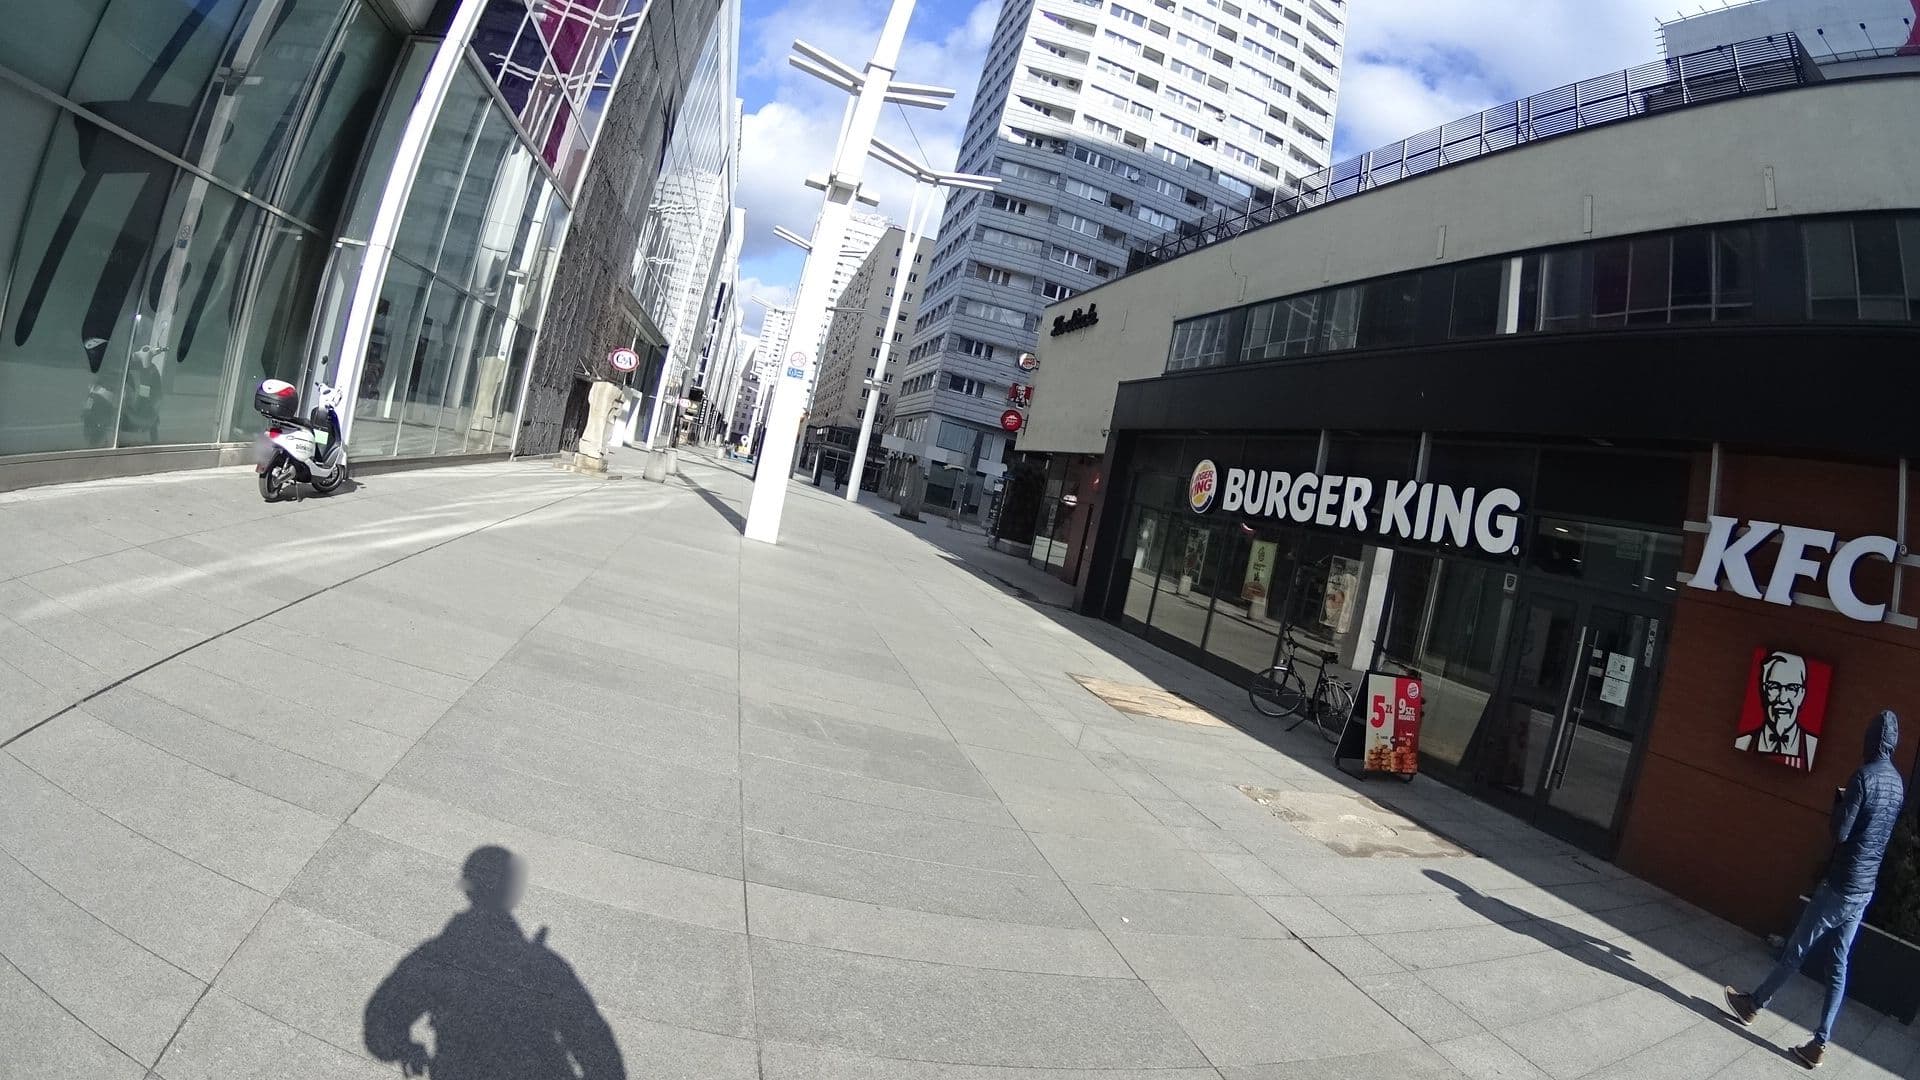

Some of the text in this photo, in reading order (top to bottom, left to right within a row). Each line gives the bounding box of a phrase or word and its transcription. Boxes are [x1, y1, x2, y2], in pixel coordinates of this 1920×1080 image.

[1222, 468, 1521, 554] BURGER KING
[1687, 514, 1898, 622] KFC
[1370, 695, 1385, 728] 5
[1398, 698, 1406, 715] 9
